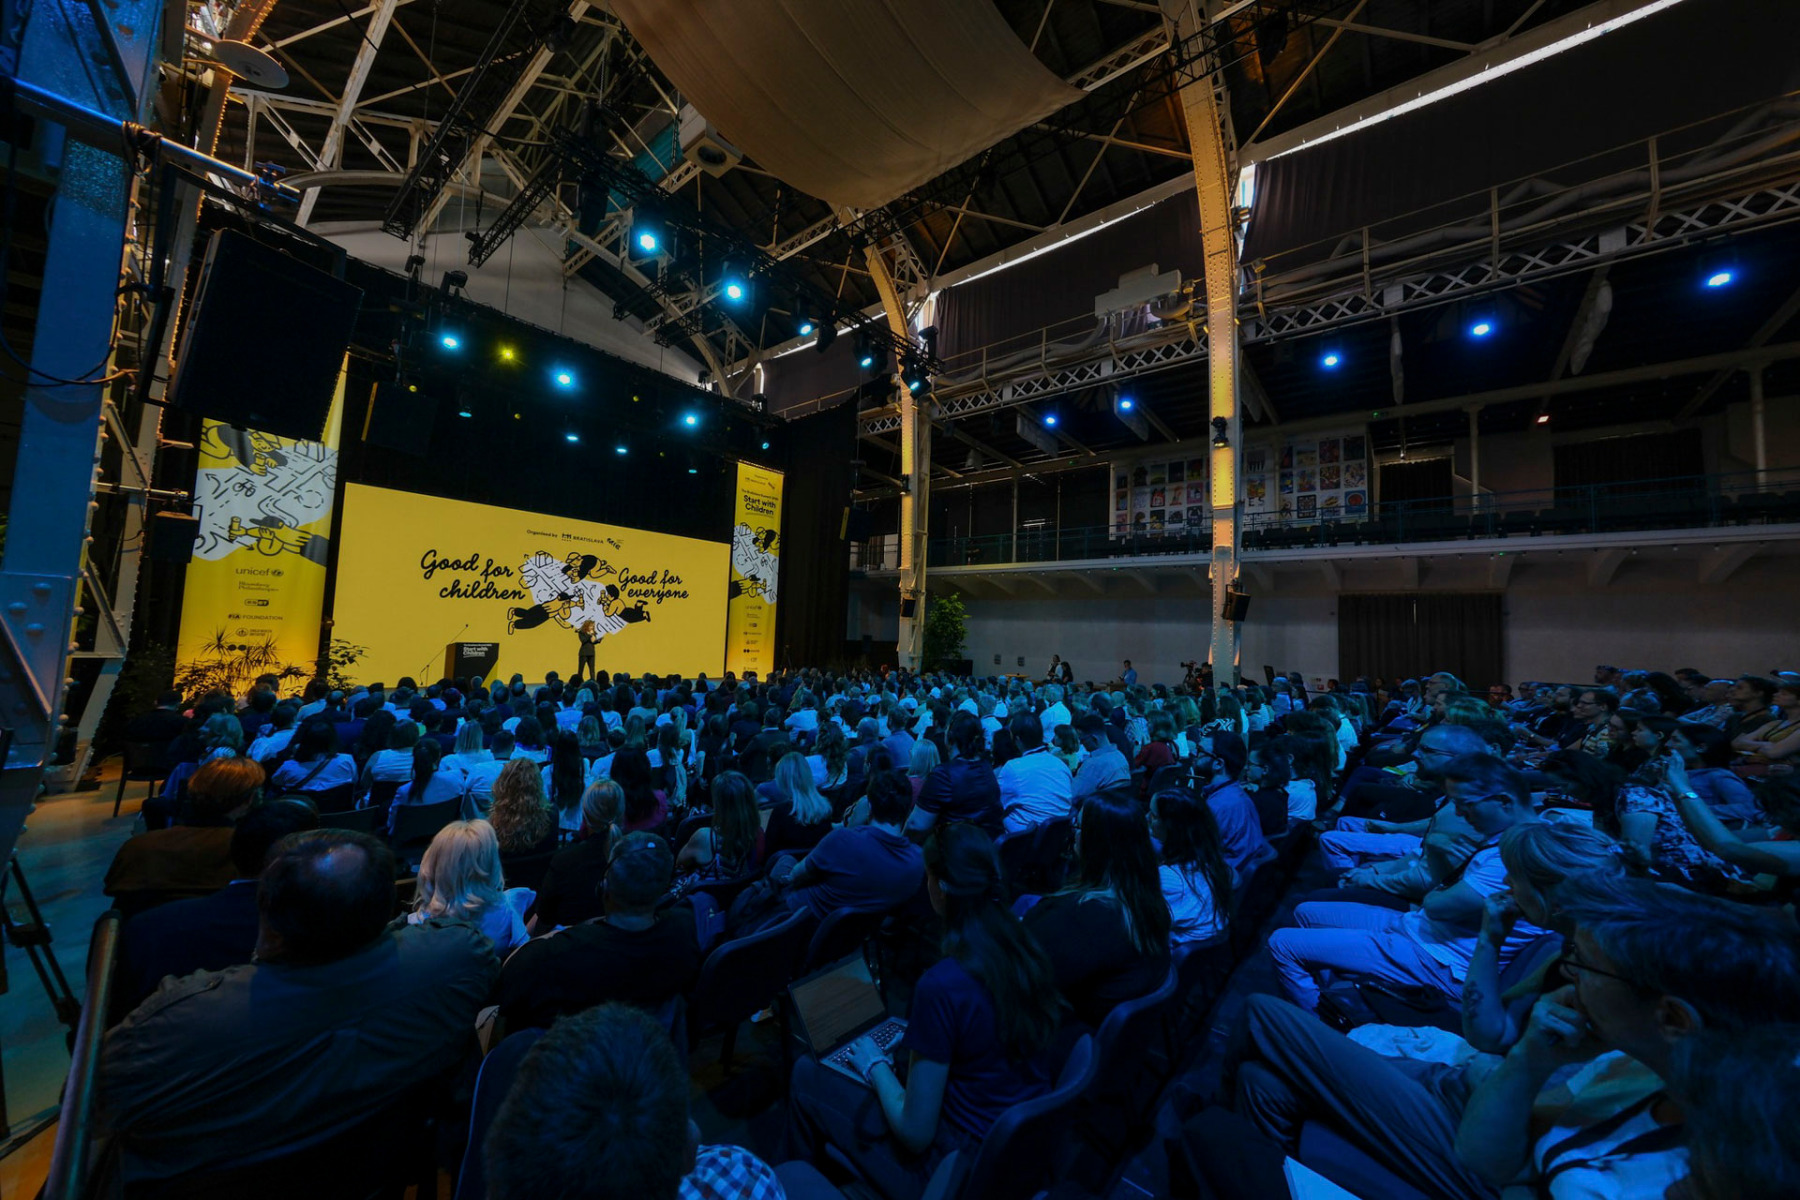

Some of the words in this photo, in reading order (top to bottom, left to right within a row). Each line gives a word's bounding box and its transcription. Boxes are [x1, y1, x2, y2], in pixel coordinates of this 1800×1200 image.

[744, 495, 760, 504] Start
[762, 500, 776, 508] with
[745, 503, 774, 515] Children
[573, 535, 604, 544] BRATISLAVA
[236, 567, 270, 576] unicef
[420, 549, 480, 580] Good
[480, 559, 514, 583] for
[618, 567, 658, 591] Good
[659, 569, 683, 589] for
[439, 579, 526, 600] children
[627, 587, 690, 604] everyone
